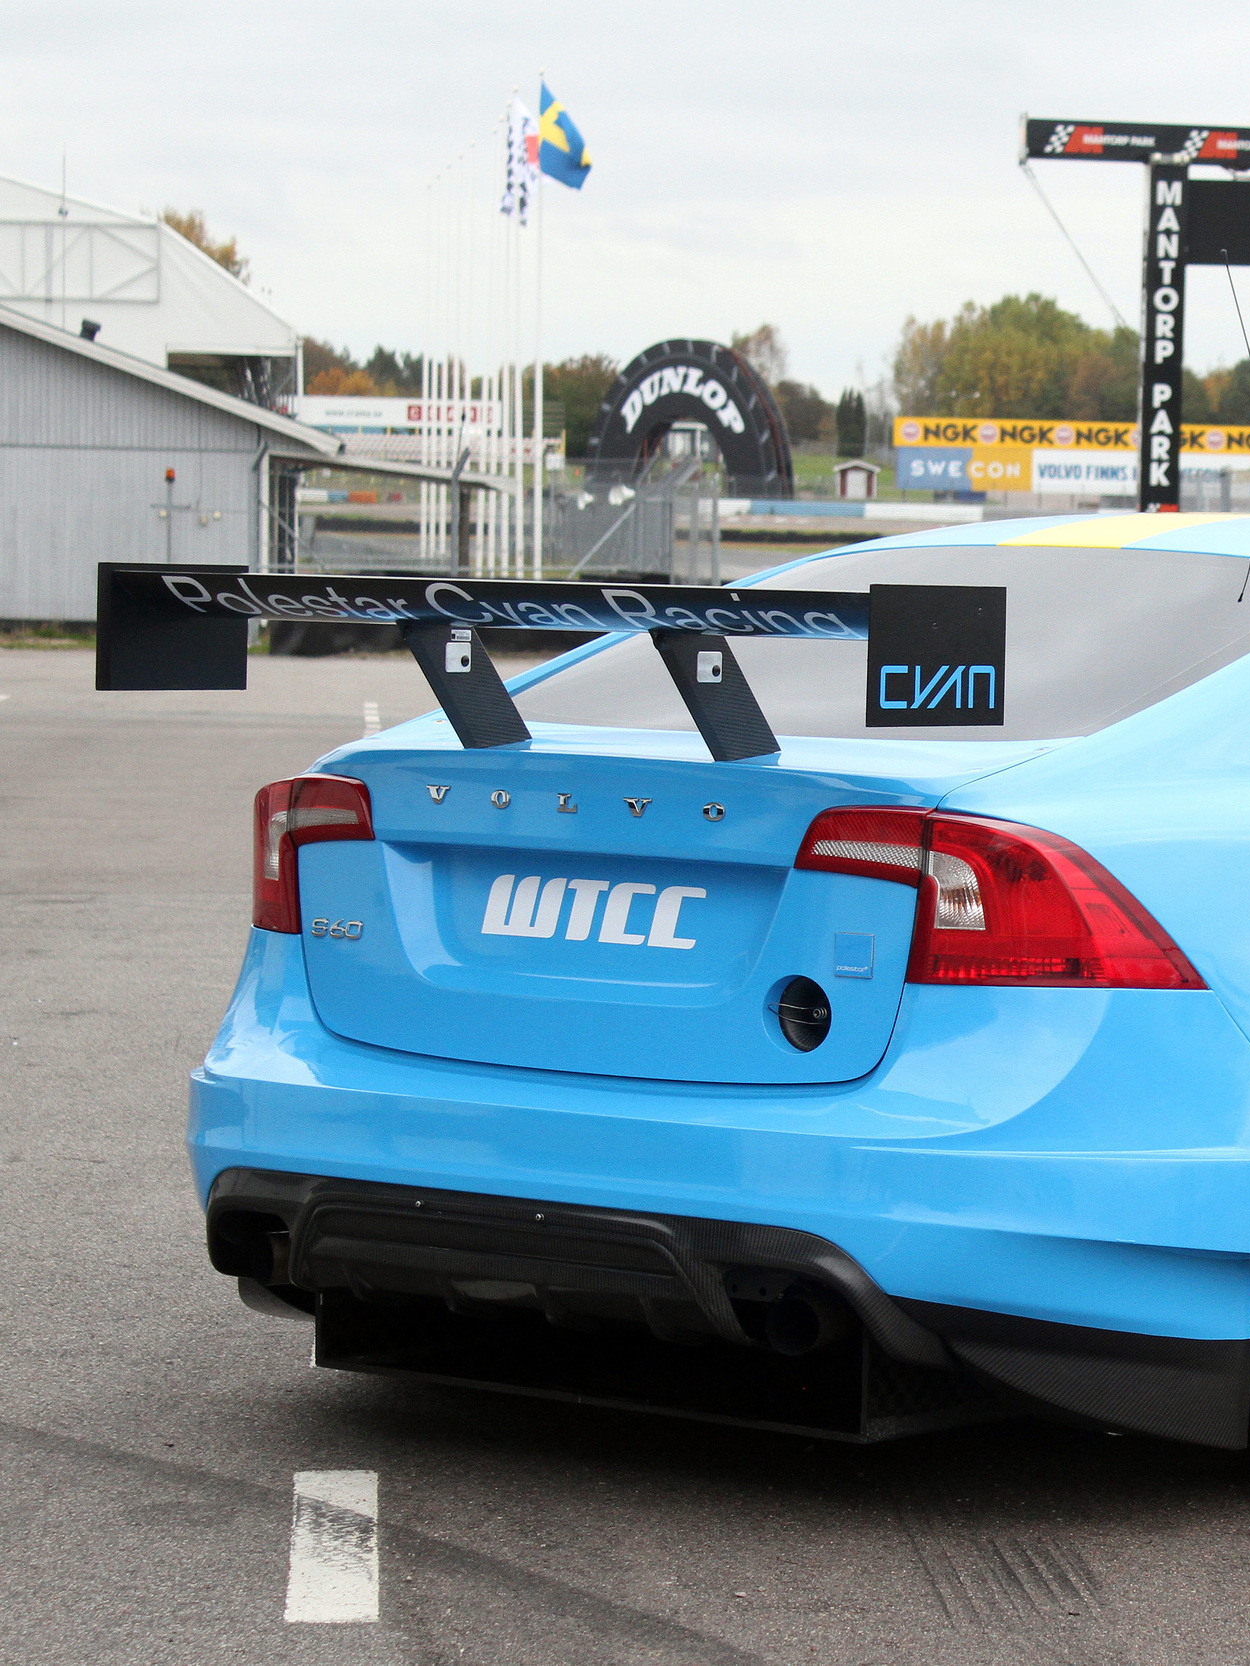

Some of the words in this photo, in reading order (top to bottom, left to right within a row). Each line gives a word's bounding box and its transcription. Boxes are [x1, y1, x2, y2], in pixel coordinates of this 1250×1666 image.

[1130, 135, 1156, 148] PARK
[1153, 180, 1183, 364] MANTORP
[620, 366, 745, 435] DUNLOP
[923, 423, 979, 442] NGK
[1000, 424, 1055, 444] NGK
[1076, 426, 1130, 447] NGK
[1149, 383, 1174, 487] PARK
[1038, 463, 1083, 480] VOLVO
[1086, 465, 1129, 482] FINNS
[161, 575, 421, 621] Polestar
[425, 582, 608, 629] Cyan
[601, 588, 860, 638] Racing
[878, 665, 996, 710] CYAN
[426, 784, 726, 822] VOLVO
[311, 917, 364, 940] S60
[481, 873, 707, 950] WTCC
